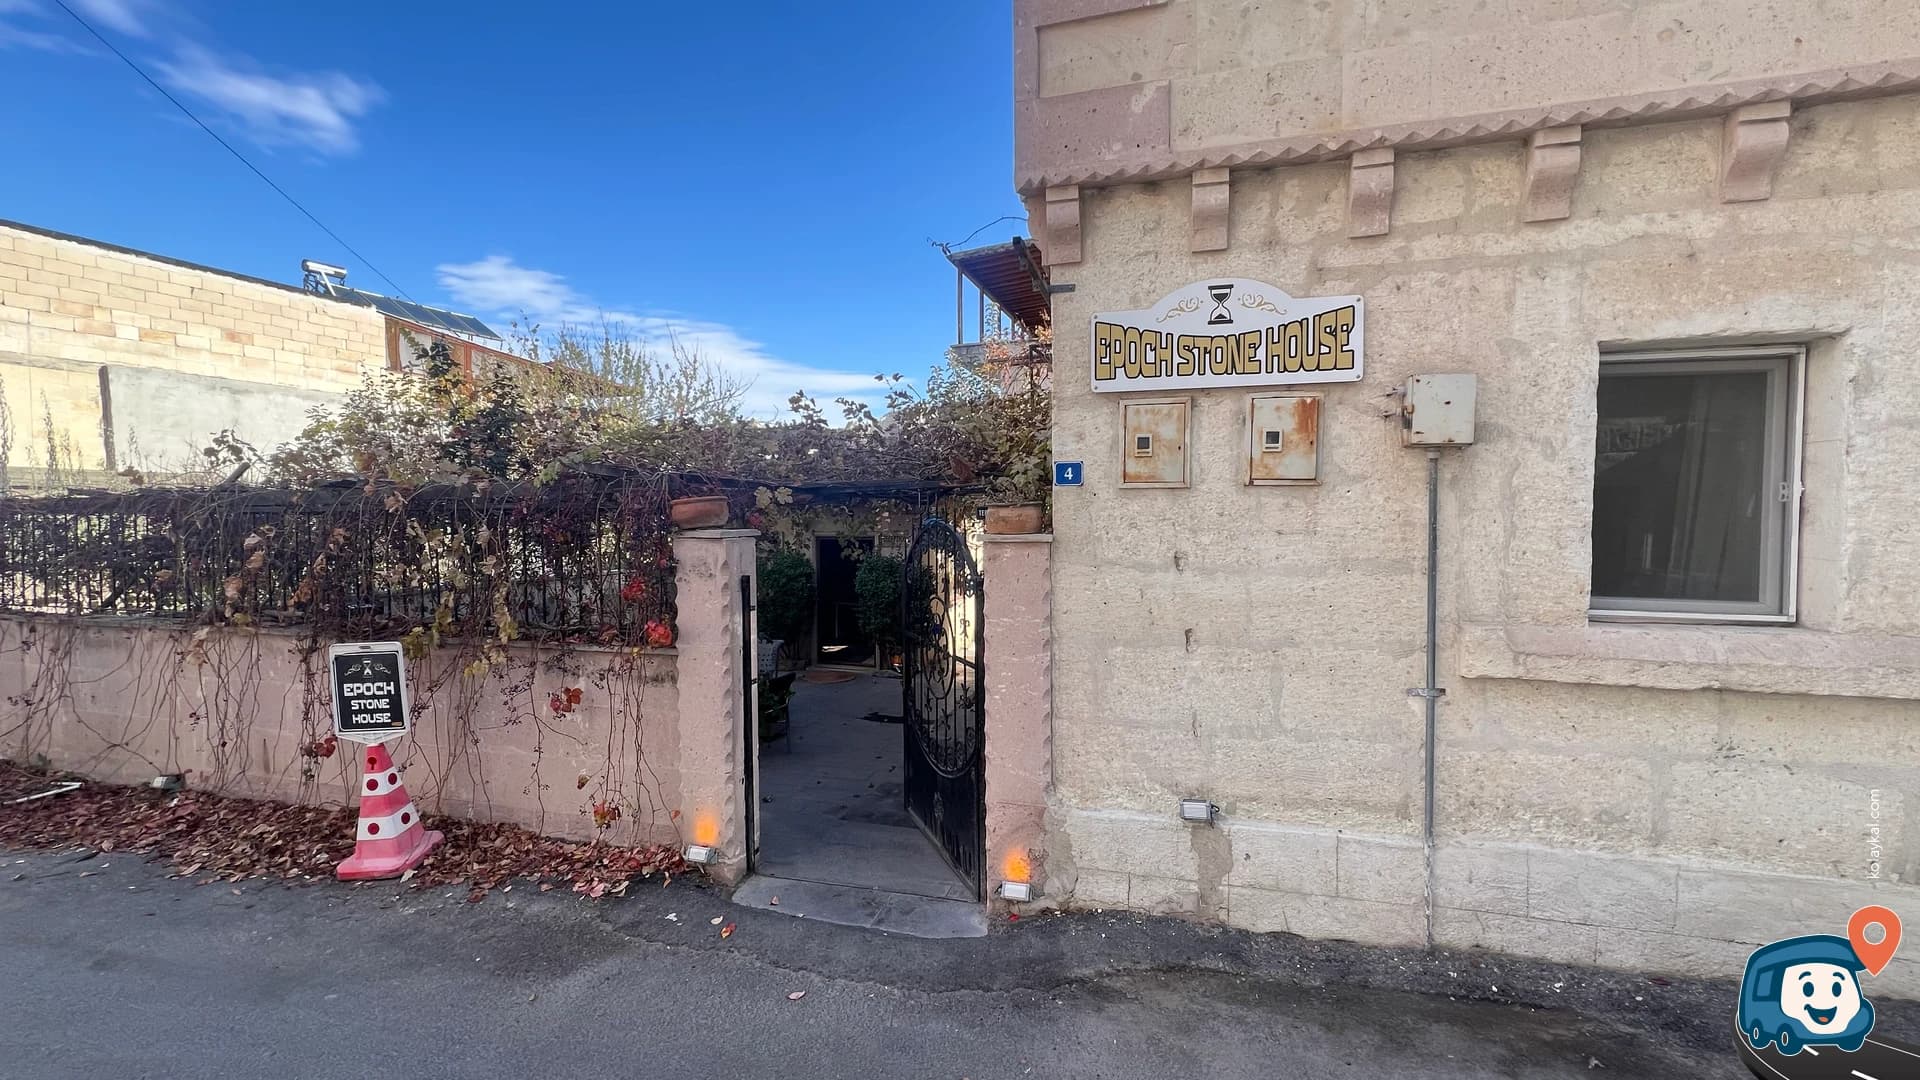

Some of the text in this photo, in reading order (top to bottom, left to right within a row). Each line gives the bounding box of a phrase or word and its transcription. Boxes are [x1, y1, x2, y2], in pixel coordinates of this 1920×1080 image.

[1095, 305, 1355, 380] EPOCH STONE HOUSE
[1063, 467, 1073, 480] 4
[343, 682, 395, 697] EPOCH
[351, 699, 390, 710] STONE
[352, 713, 391, 724] HOUSE
